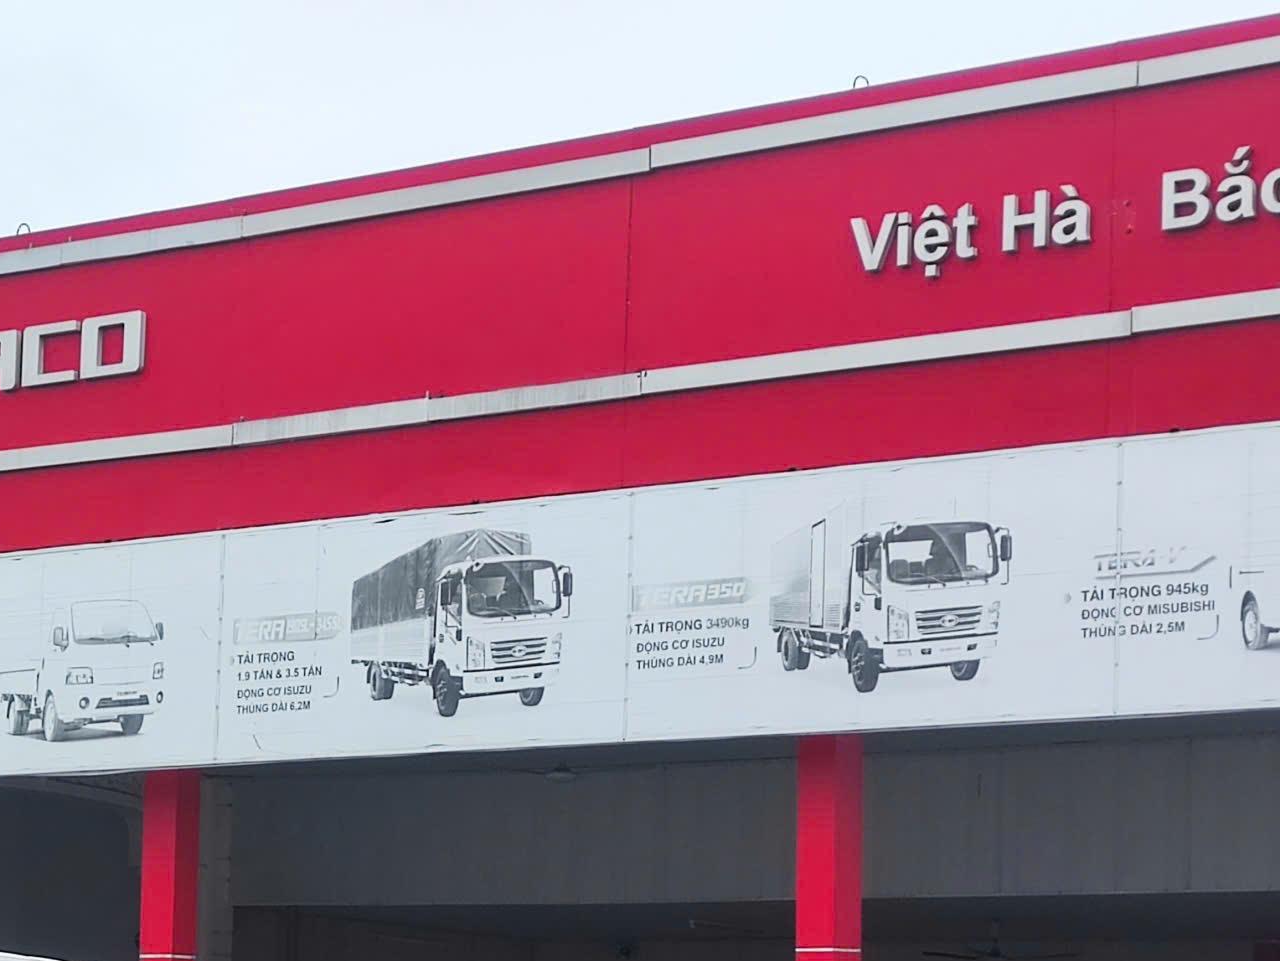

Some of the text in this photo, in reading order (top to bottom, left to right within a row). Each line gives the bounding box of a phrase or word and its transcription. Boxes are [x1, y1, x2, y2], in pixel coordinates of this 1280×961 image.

[850, 202, 978, 278] Việt
[1001, 184, 1091, 254] Hà
[1081, 582, 1210, 602] TẢI TRỌNG 945kg
[1123, 604, 1144, 618] CƠ
[1147, 600, 1215, 615] MISUBISHI
[634, 617, 750, 635] TẢI TRỌNG 3490kg
[1156, 620, 1185, 636] 2,5M
[671, 639, 690, 650] CƠ
[691, 636, 725, 649] ISUZU
[237, 650, 295, 665] TẢI TRỌNG
[275, 668, 283, 679] &
[266, 686, 282, 696] CƠ
[283, 684, 312, 696] ISUZU
